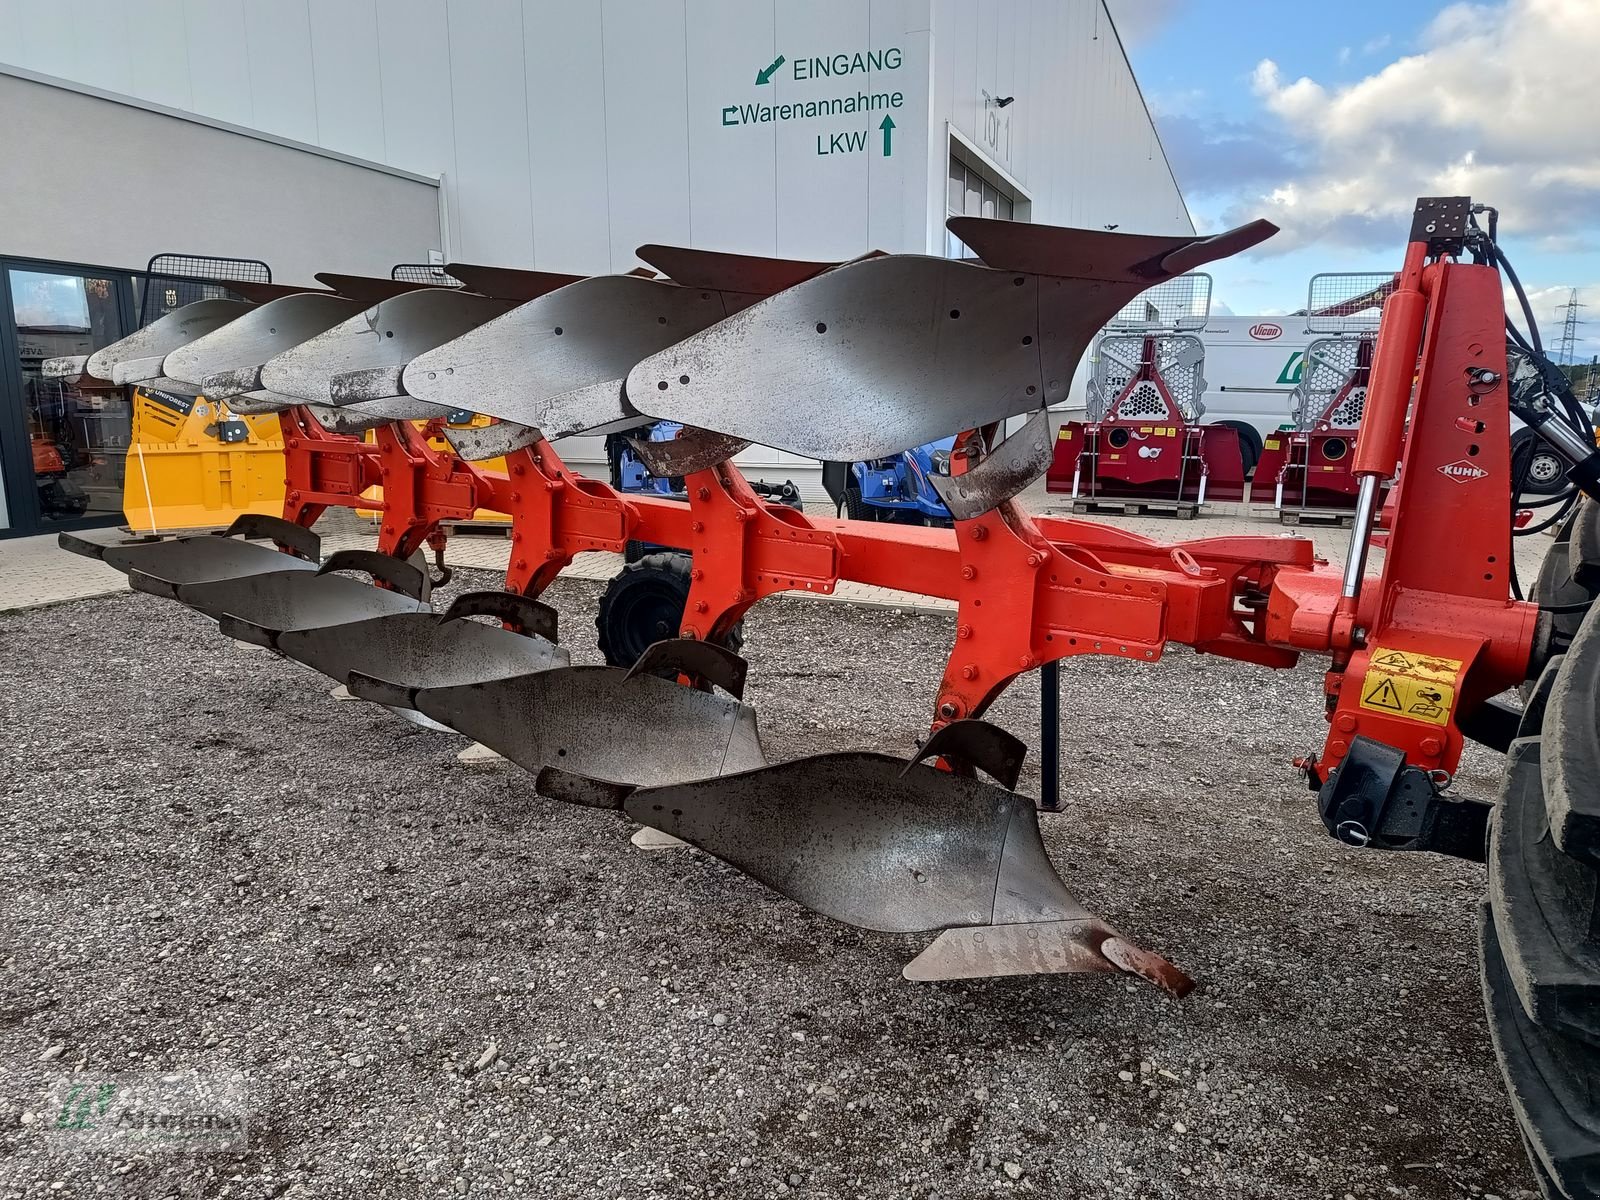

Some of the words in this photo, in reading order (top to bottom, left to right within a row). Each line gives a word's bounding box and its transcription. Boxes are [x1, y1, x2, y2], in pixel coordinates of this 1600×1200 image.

[793, 47, 902, 81] EINGANG
[739, 91, 904, 125] Warenannahme
[817, 130, 868, 155] LKW
[1253, 324, 1279, 336] Vicon
[154, 388, 191, 410] UNIFOREST
[1443, 465, 1482, 477] KUHN
